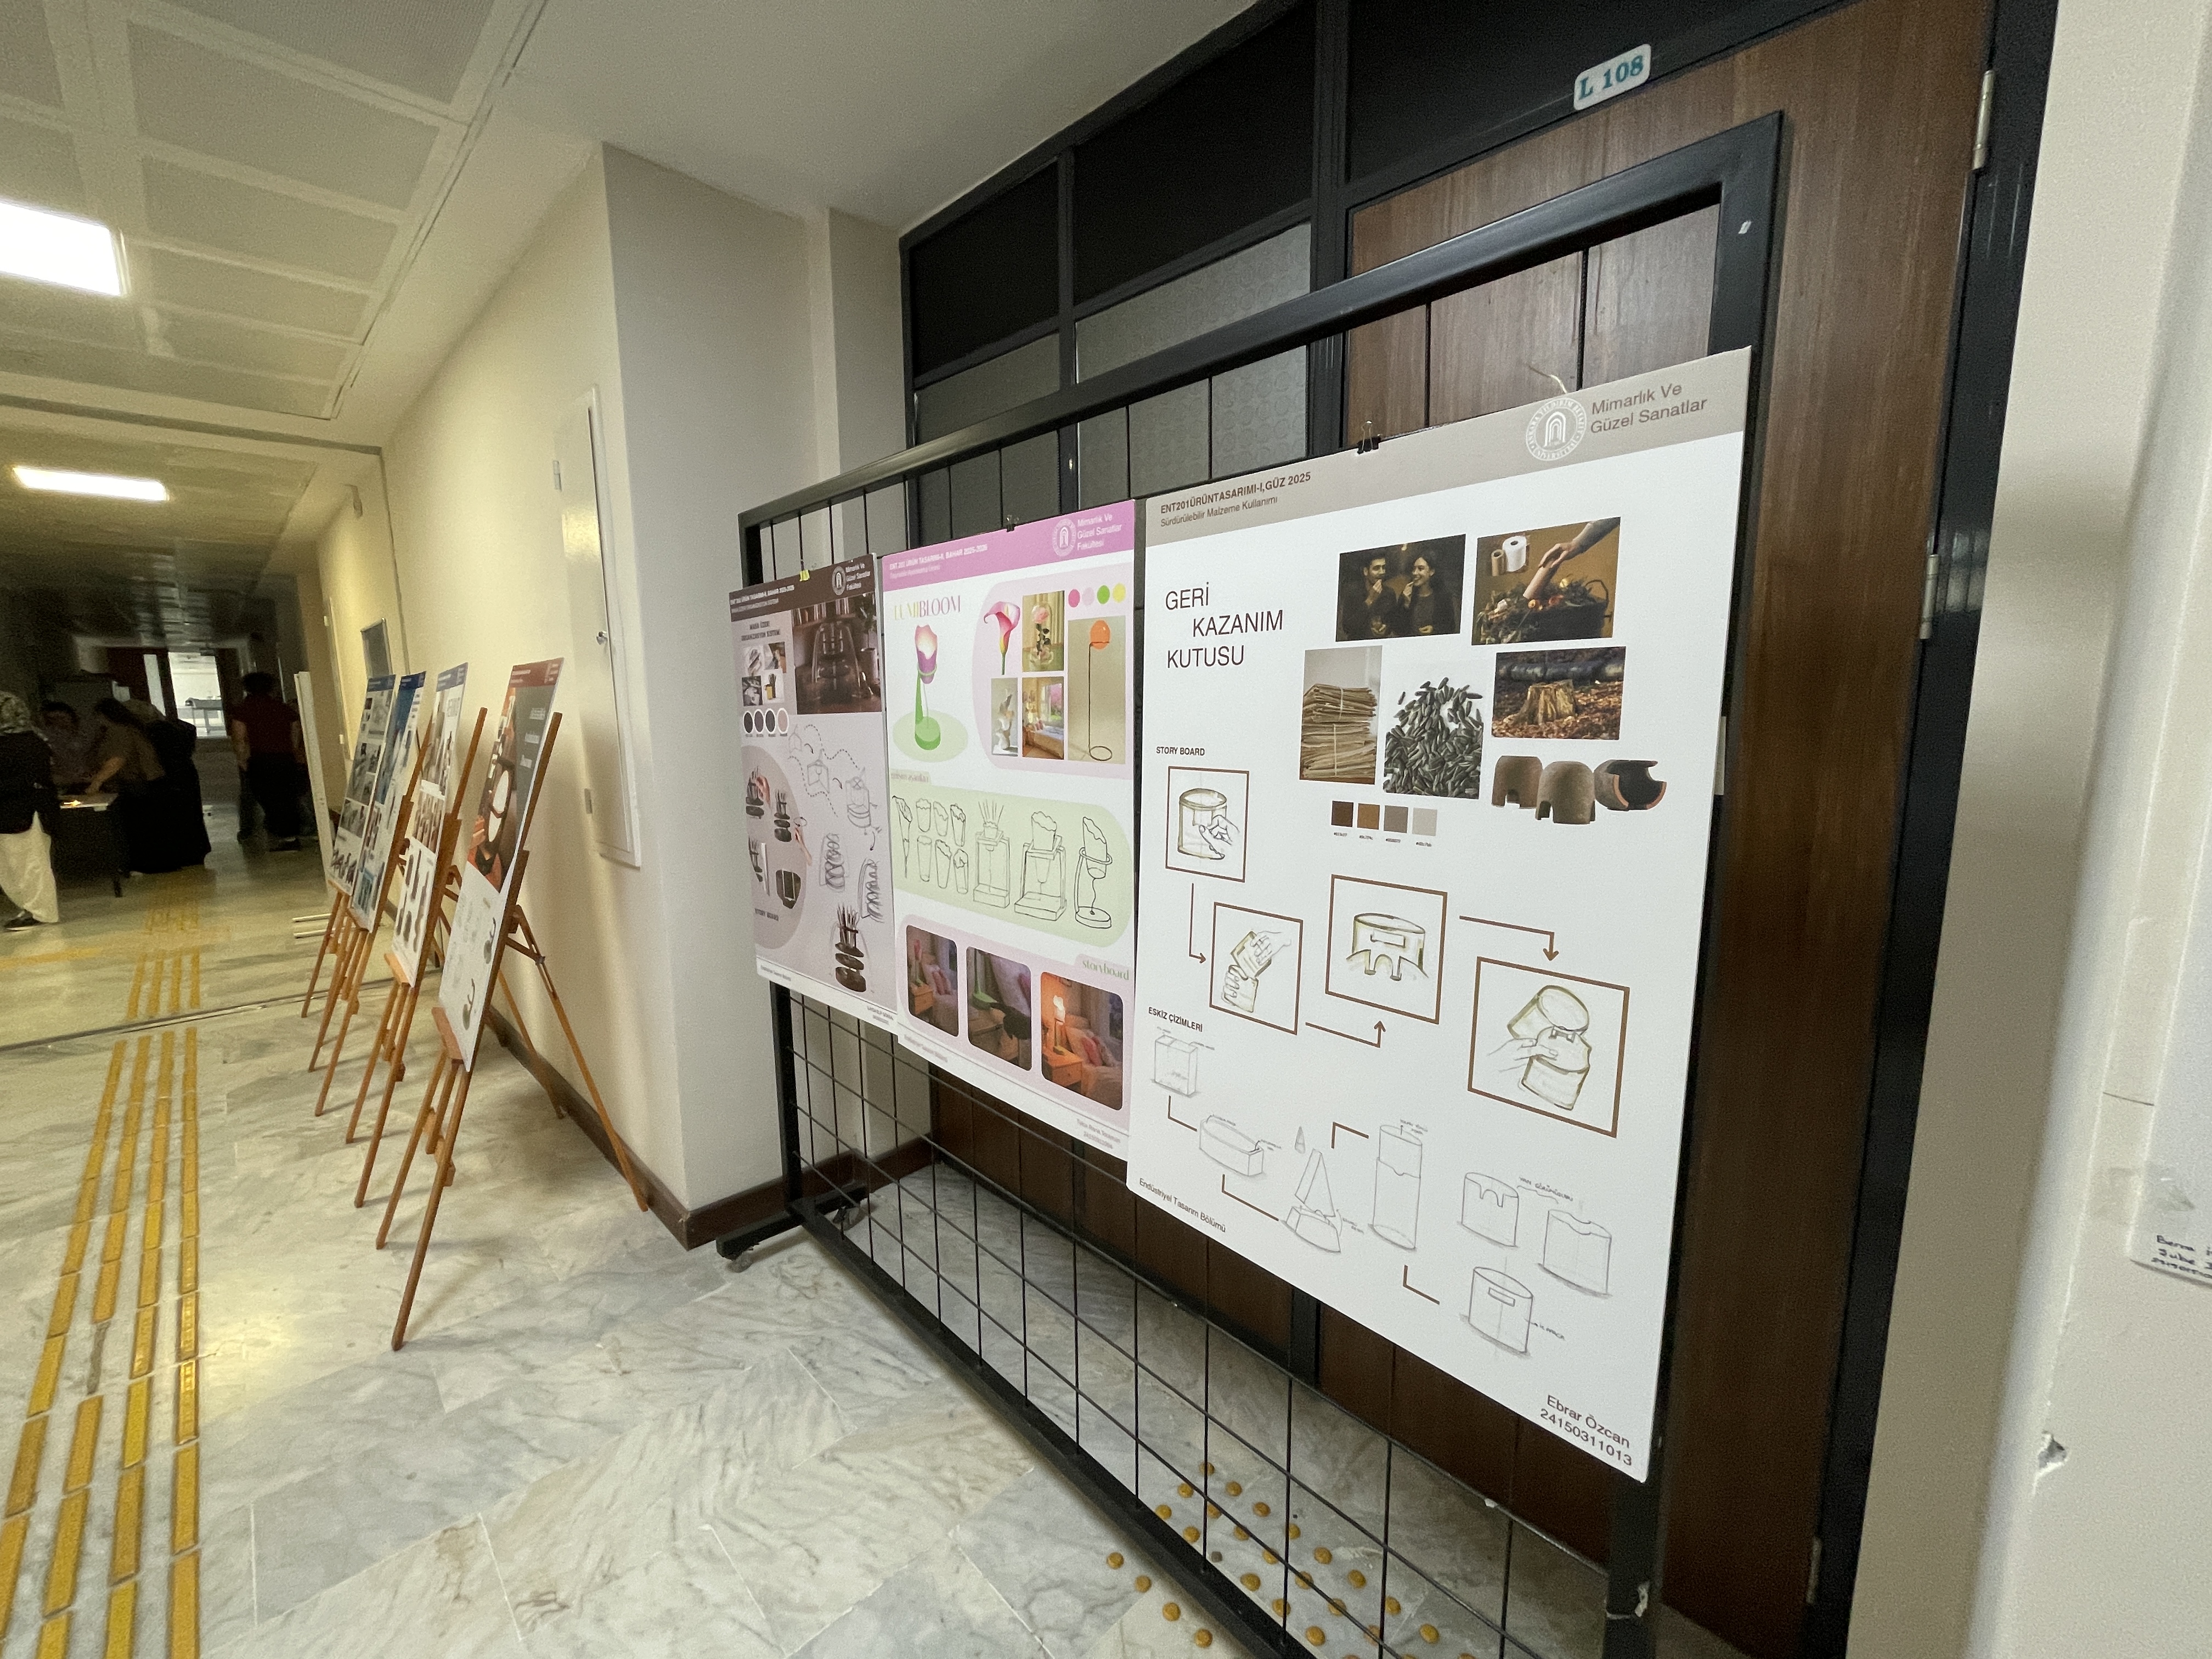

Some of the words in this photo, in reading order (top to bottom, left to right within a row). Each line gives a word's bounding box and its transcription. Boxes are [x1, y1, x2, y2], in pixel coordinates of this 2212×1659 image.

[1578, 76, 1593, 100] L
[1603, 55, 1644, 89] 108
[1592, 387, 1656, 415] Mimarlık
[1660, 383, 1683, 398] Ve
[1591, 413, 1634, 433] Güzel
[1638, 399, 1708, 424] Sanatlar
[1288, 471, 1311, 486] 2025
[1160, 510, 1205, 527] Sürdürülebilir
[1207, 504, 1240, 518] Malzeme
[1242, 496, 1278, 510] Kullanımı
[1165, 582, 1209, 610] GERİ
[1193, 610, 1283, 637] KAZANIM
[1167, 645, 1244, 668] KUTUSU
[1156, 746, 1178, 755] STORY
[1180, 747, 1205, 756] BOARD
[1082, 959, 1129, 980] storyboard
[1148, 1006, 1167, 1020] ESKİZ
[1169, 1014, 1203, 1032] ÇİZİMLERİ
[1139, 1177, 1172, 1202] Endüstriyel
[1173, 1196, 1199, 1218] Tasarım
[1200, 1211, 1226, 1233] Bölümü
[1547, 1394, 1582, 1421] Ebrar
[1585, 1413, 1629, 1448] Özcan
[1540, 1408, 1632, 1466] 24150311013
